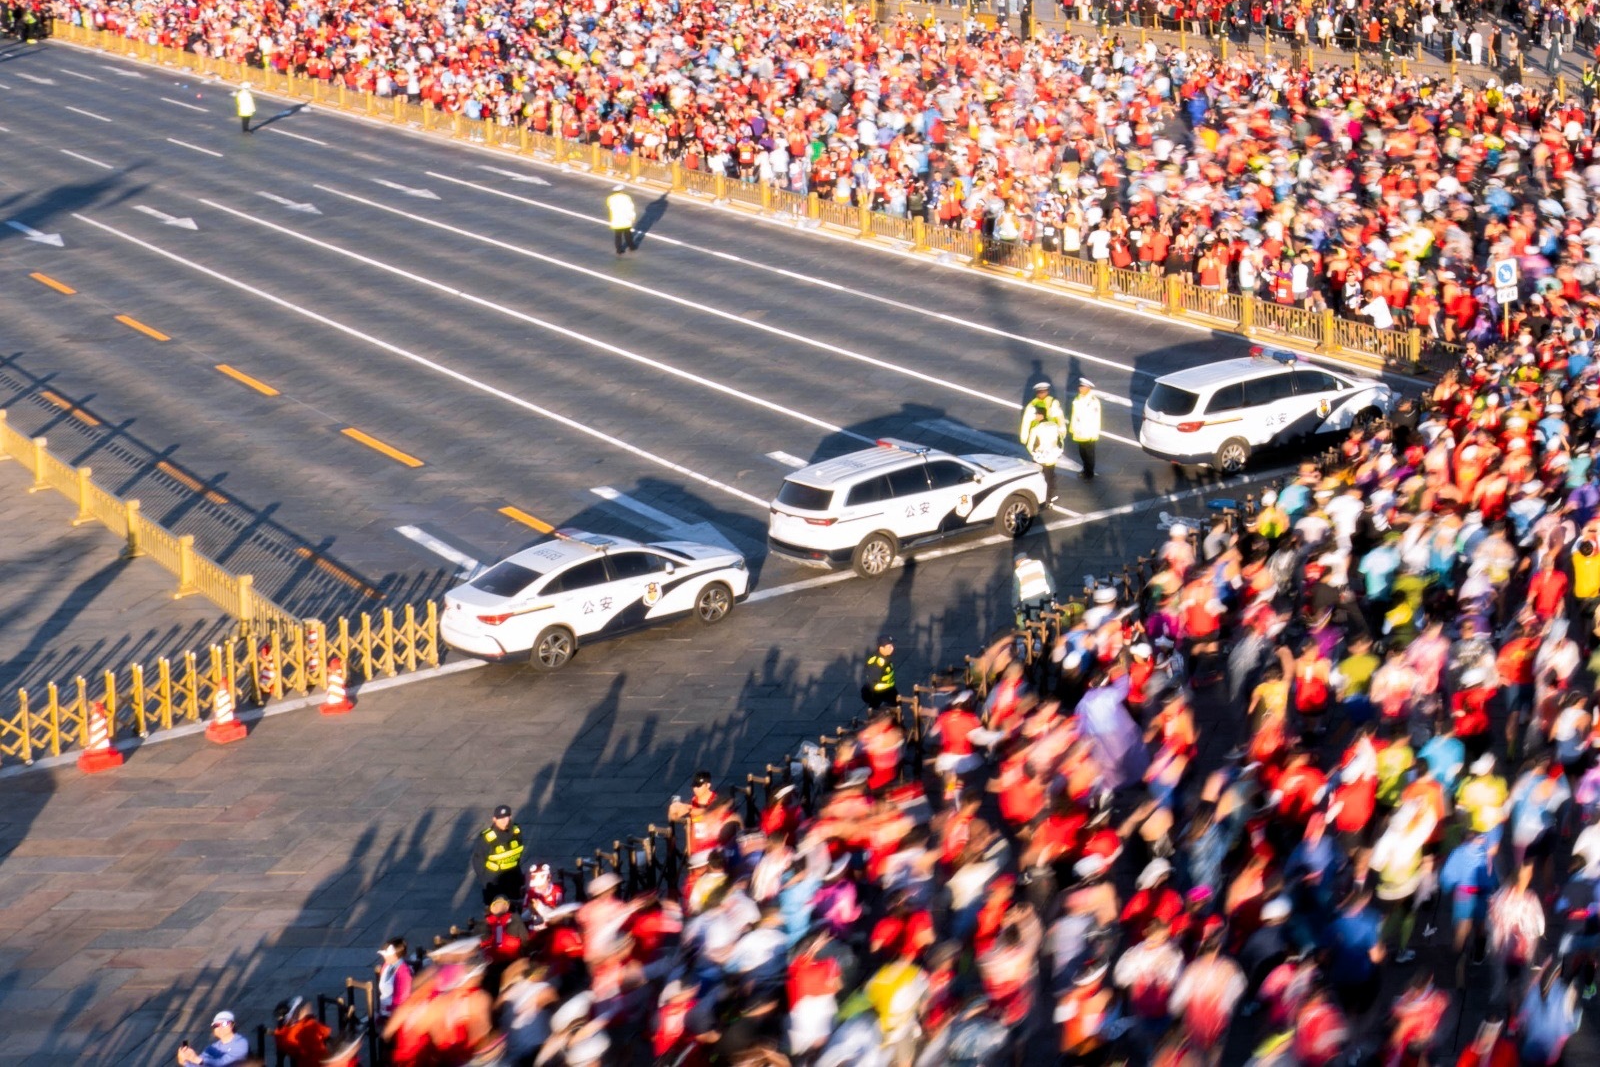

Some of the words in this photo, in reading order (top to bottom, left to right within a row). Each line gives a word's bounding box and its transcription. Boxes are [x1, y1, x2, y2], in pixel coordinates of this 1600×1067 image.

[1264, 412, 1287, 427] 公安
[904, 501, 931, 519] 公安
[582, 595, 614, 615] 公安
